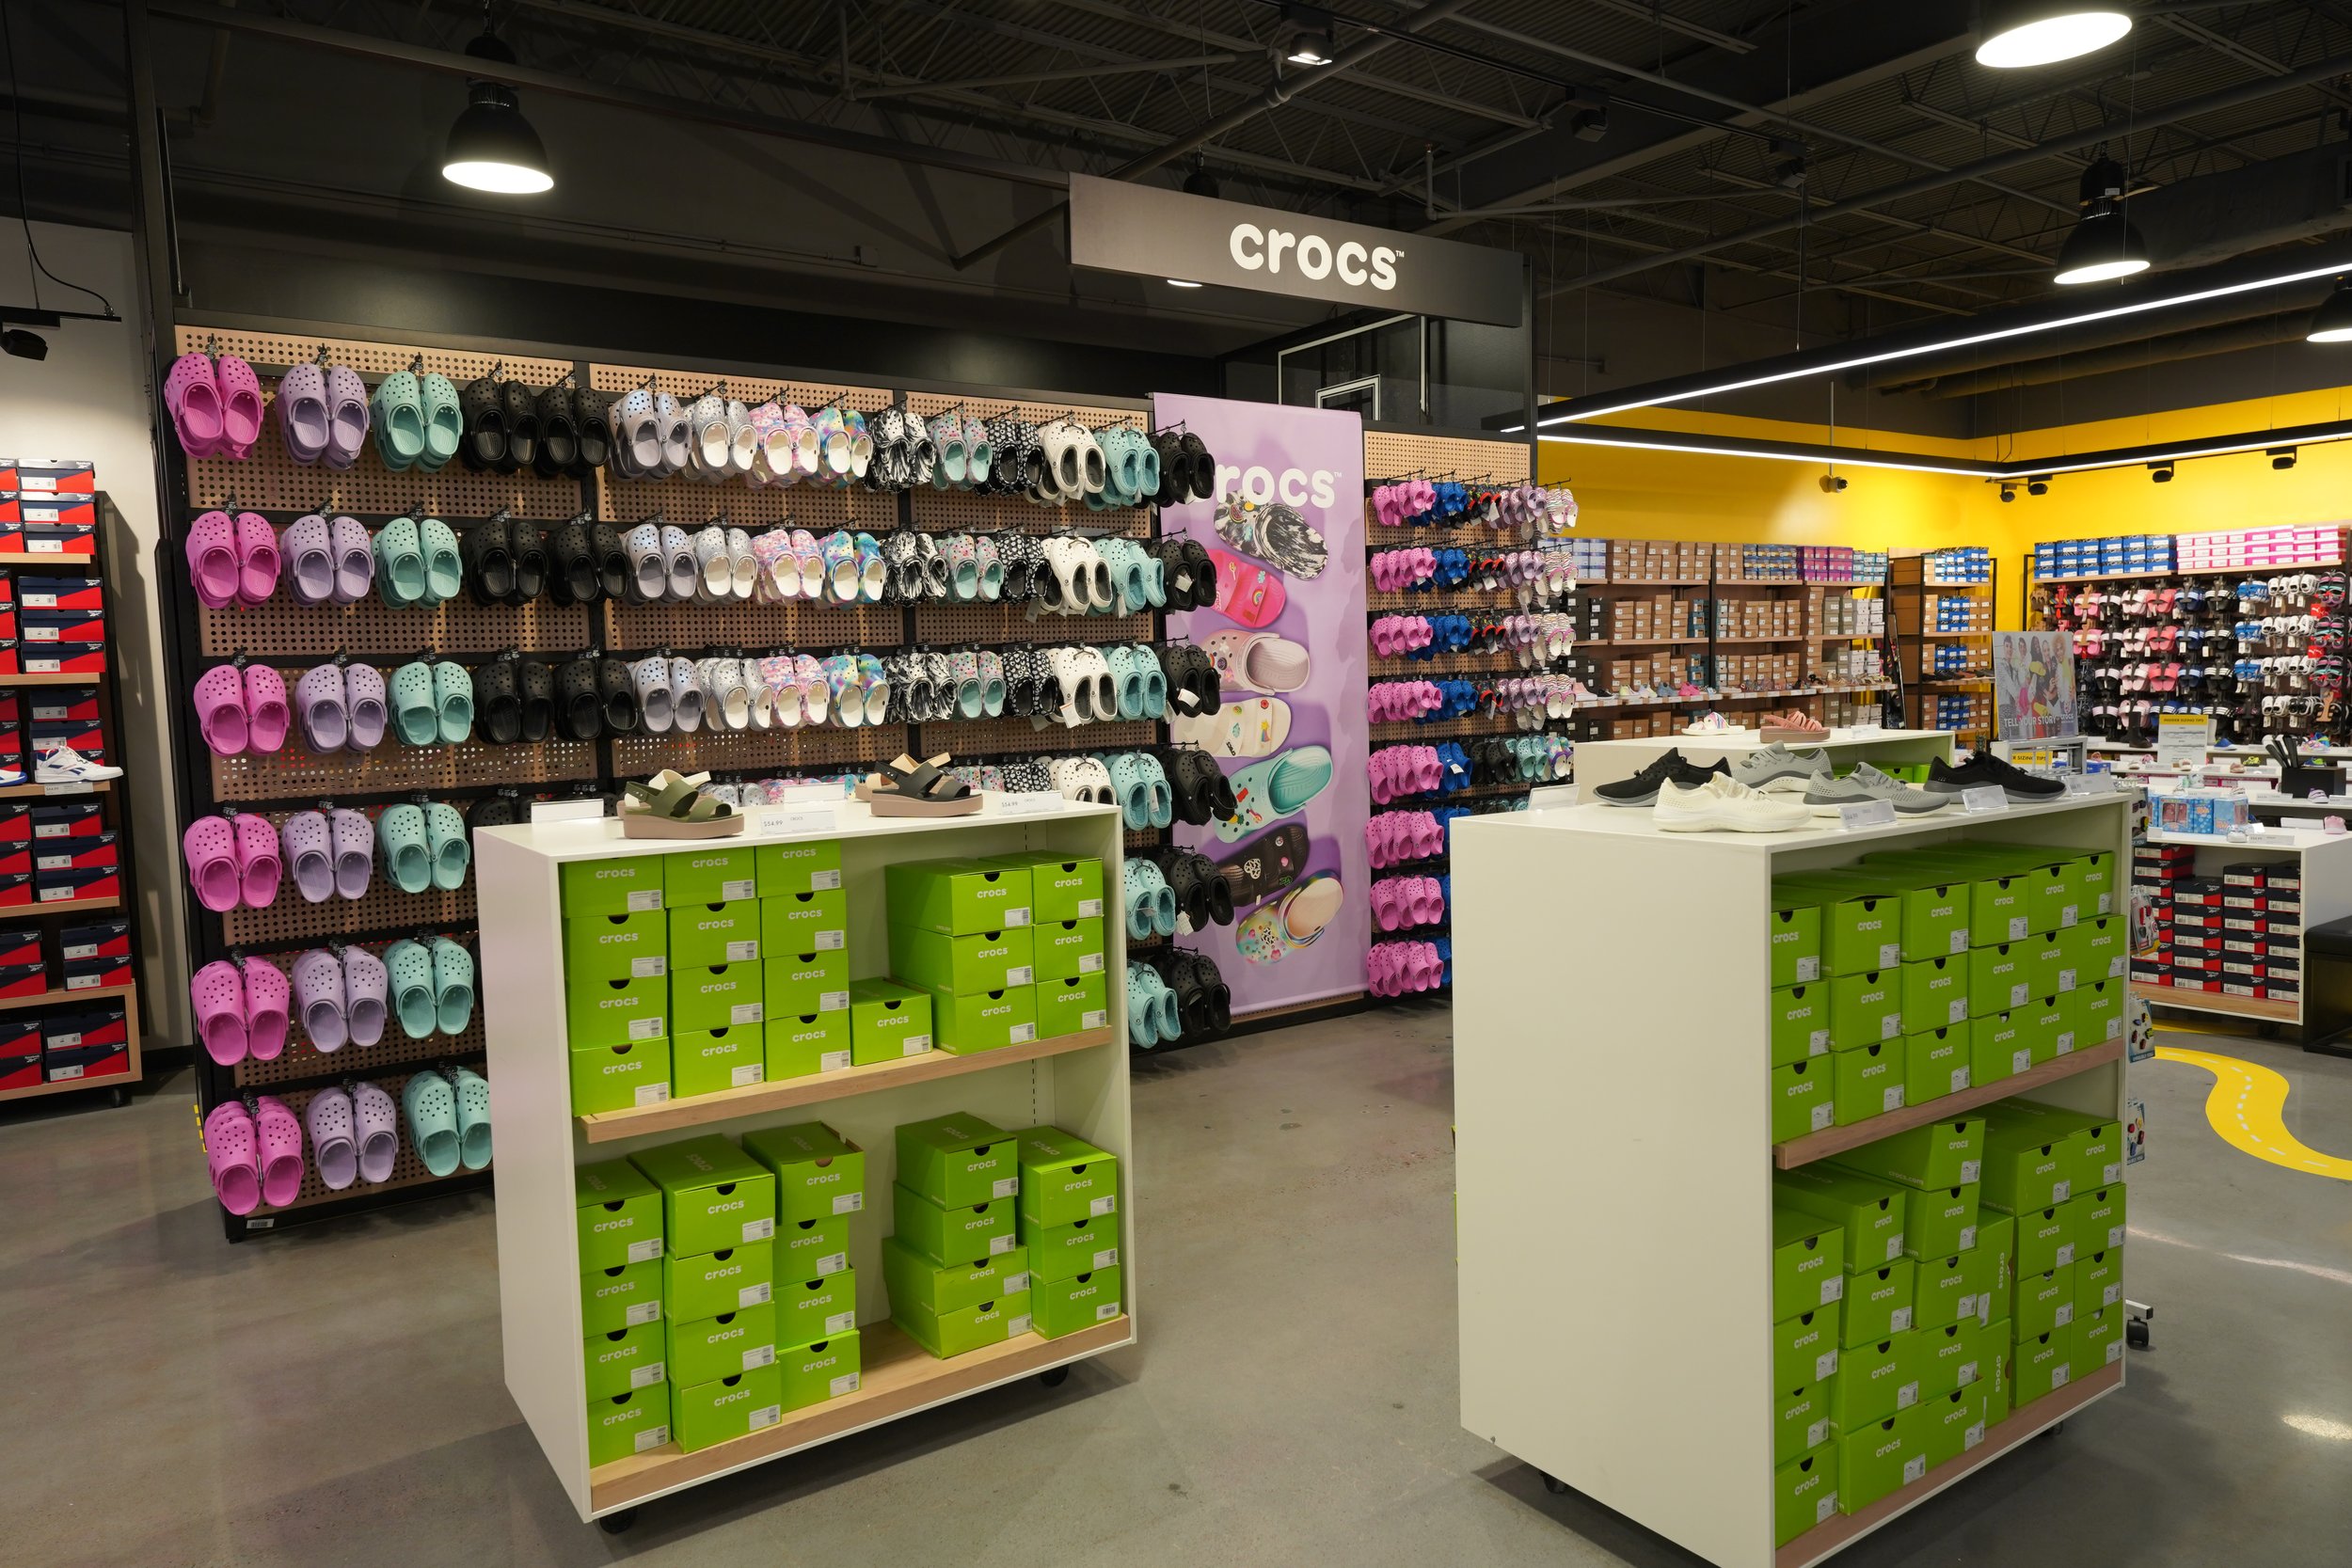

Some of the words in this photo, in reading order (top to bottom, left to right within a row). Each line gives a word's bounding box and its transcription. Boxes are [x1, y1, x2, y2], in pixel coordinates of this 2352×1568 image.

[2004, 718, 2019, 727] TELL
[2020, 717, 2037, 726] YOUR
[763, 819, 784, 828] $54.99
[783, 848, 817, 858] crocs
[692, 857, 728, 867] crocs
[596, 868, 636, 879] crocs
[2086, 872, 2103, 881] crocs
[1055, 878, 1083, 887] crocs
[977, 888, 1008, 897] crocs
[2046, 884, 2064, 895] crocs
[1994, 895, 2014, 908] crocs
[788, 909, 822, 919] crocs
[1931, 906, 1953, 917] crocs
[698, 919, 735, 929] crocs
[1858, 919, 1883, 930] crocs
[599, 932, 639, 942] crocs
[1056, 935, 1084, 944] crocs
[1772, 931, 1799, 944] crocs
[2092, 935, 2111, 946] crocs
[978, 947, 1009, 958] crocs
[2042, 948, 2061, 959] crocs
[792, 969, 826, 980] crocs
[1994, 962, 2014, 974] crocs
[701, 981, 737, 992] crocs
[1930, 976, 1952, 989] crocs
[600, 996, 639, 1008] crocs
[1058, 990, 1086, 1002] crocs
[1861, 991, 1884, 1004] crocs
[2091, 998, 2108, 1008] crocs
[982, 1005, 1011, 1016] crocs
[1788, 1006, 1812, 1020] crocs
[878, 1015, 909, 1026] crocs
[2041, 1012, 2060, 1023] crocs
[793, 1030, 826, 1041] crocs
[1994, 1029, 2015, 1041] crocs
[702, 1043, 738, 1056] crocs
[1931, 1045, 1954, 1059] crocs
[603, 1061, 643, 1074] crocs
[1863, 1064, 1886, 1077] crocs
[1788, 1081, 1814, 1096] crocs
[1949, 1139, 1969, 1148] crocs
[2087, 1144, 2106, 1155] crocs
[968, 1159, 997, 1171] crocs
[2036, 1162, 2056, 1174] crocs
[807, 1173, 840, 1185] crocs
[1065, 1179, 1092, 1191] crocs
[707, 1199, 745, 1213] crocs
[1945, 1205, 1964, 1217] crocs
[2092, 1207, 2111, 1219] crocs
[595, 1217, 633, 1232] crocs
[965, 1216, 994, 1228] crocs
[1873, 1214, 1894, 1228] crocs
[2039, 1225, 2060, 1238] crocs
[791, 1234, 824, 1248] crocs
[1067, 1233, 1094, 1245] crocs
[1799, 1256, 1824, 1272] crocs
[705, 1265, 742, 1279] crocs
[970, 1267, 995, 1279] crocs
[1997, 1252, 2006, 1290] crocs
[2090, 1266, 2108, 1279] crocs
[1941, 1275, 1963, 1288] crocs
[597, 1281, 634, 1297] crocs
[1070, 1286, 1097, 1299] crocs
[1871, 1286, 1895, 1300] crocs
[2039, 1286, 2058, 1300] crocs
[799, 1294, 832, 1308] crocs
[976, 1310, 1001, 1323] crocs
[707, 1327, 744, 1342] crocs
[2089, 1323, 2108, 1338] crocs
[1794, 1331, 1819, 1348] crocs
[599, 1346, 637, 1362] crocs
[1939, 1343, 1962, 1356] crocs
[2034, 1348, 2055, 1362] crocs
[803, 1356, 836, 1371] crocs
[1872, 1362, 1896, 1378] crocs
[1994, 1354, 2003, 1393] crocs
[715, 1389, 751, 1405] crocs
[604, 1408, 642, 1425] crocs
[1786, 1401, 1811, 1419] crocs
[1945, 1406, 1967, 1423] crocs
[1877, 1438, 1901, 1456] crocs
[1795, 1474, 1820, 1495] crocs
